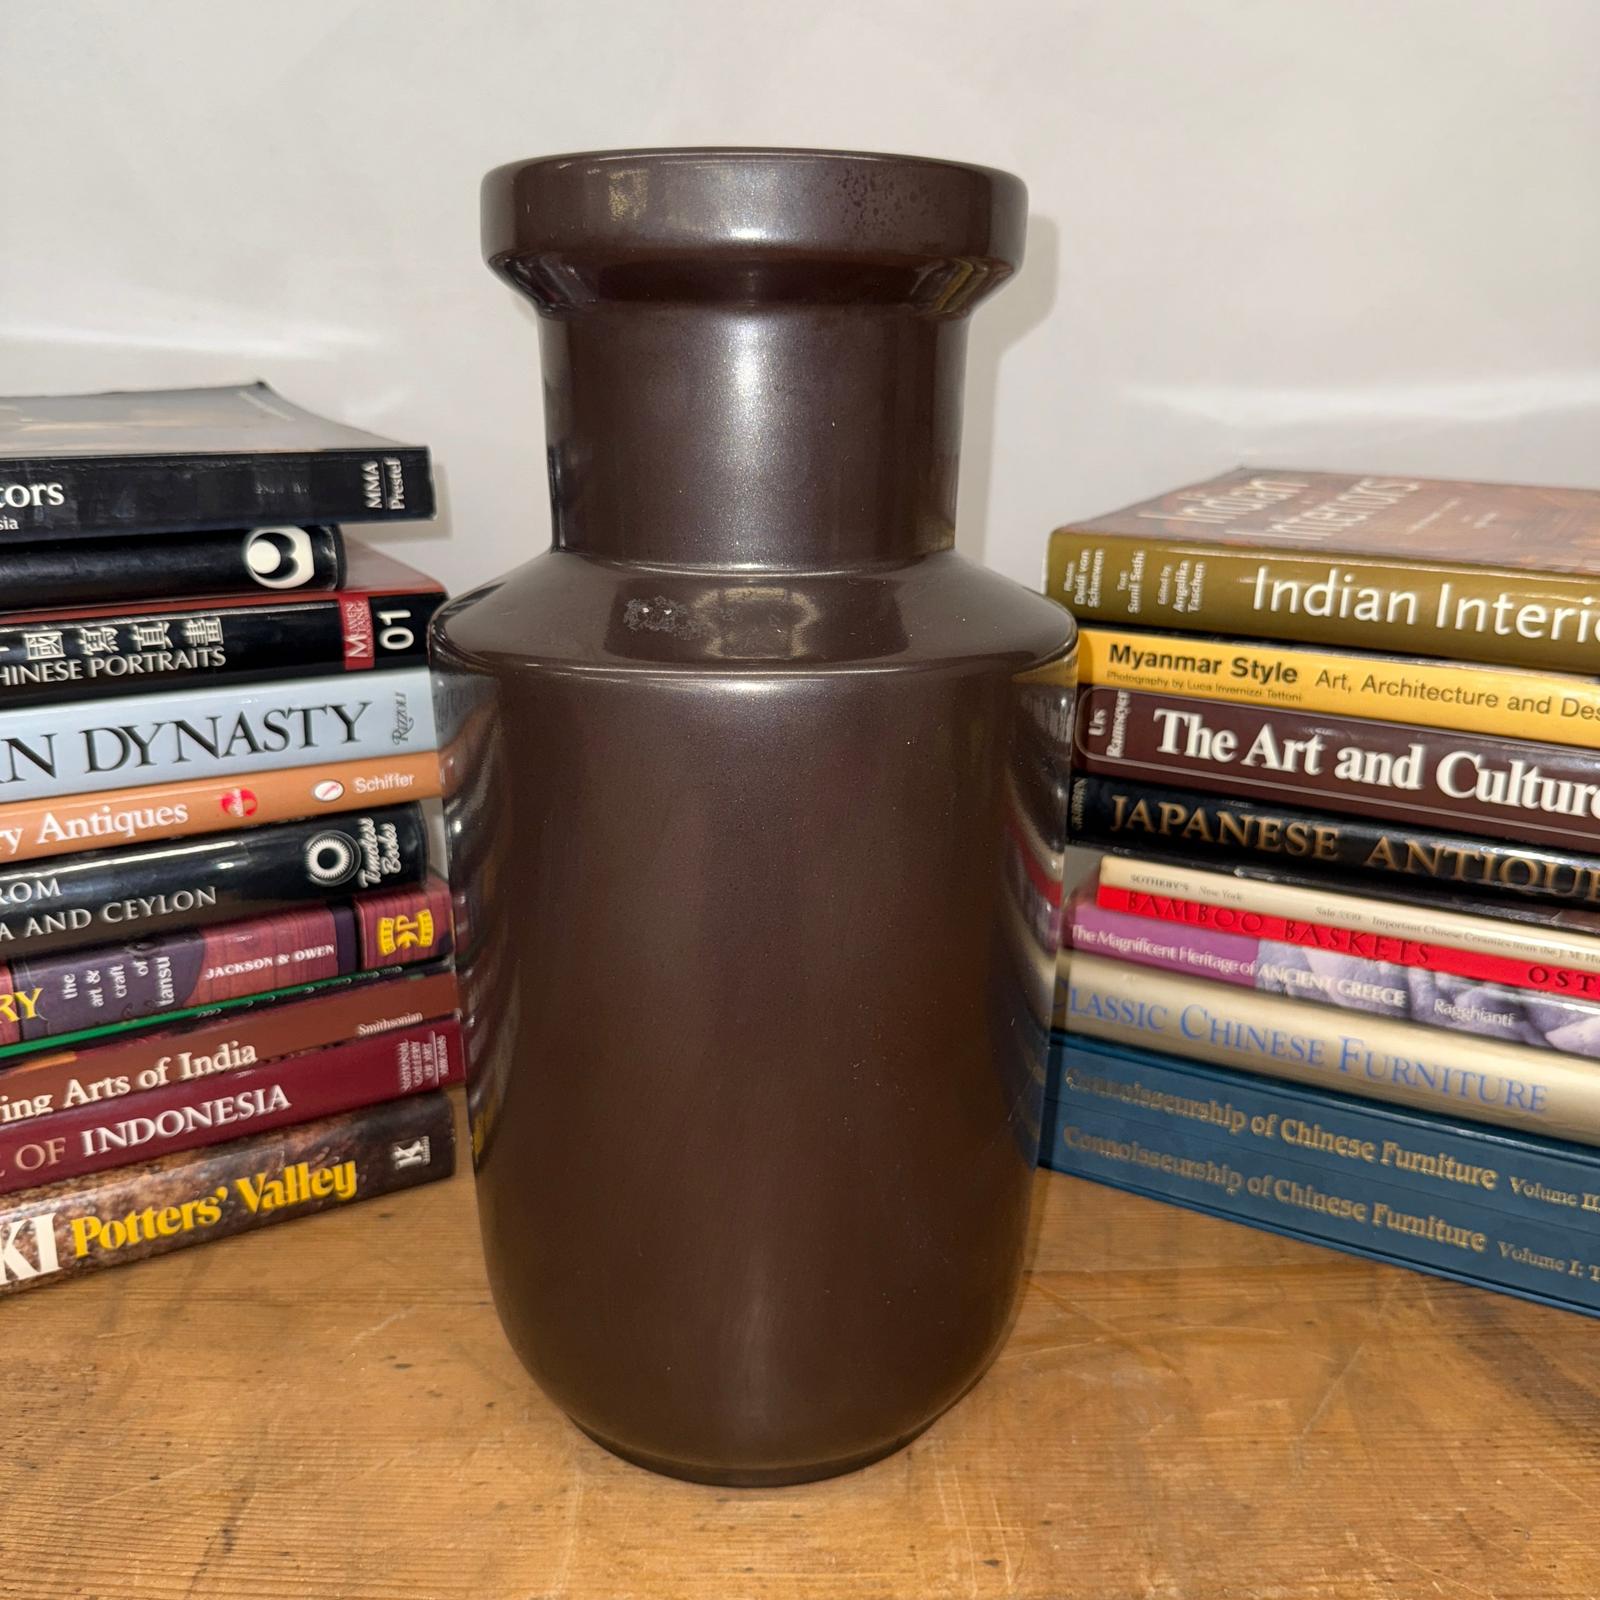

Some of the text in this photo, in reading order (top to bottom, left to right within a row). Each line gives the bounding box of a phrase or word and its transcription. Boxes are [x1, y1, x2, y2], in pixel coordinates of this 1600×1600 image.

[361, 459, 383, 509] MMA
[383, 457, 405, 510] Prestel
[1128, 550, 1145, 614] Sunil Sethi
[1173, 560, 1190, 612] Angelika
[1188, 561, 1205, 613] Taschen
[1253, 566, 1600, 644] Indian Interi
[0, 616, 224, 661] 國寫真畫
[377, 609, 415, 650] 01
[88, 647, 227, 678] PORTRAITS
[1106, 671, 1169, 688] Photography
[1172, 676, 1184, 690] by
[1186, 681, 1213, 692] Luca
[1109, 643, 1222, 675] Myanmar
[1231, 657, 1298, 684] Style
[1314, 669, 1352, 695] Art,
[1360, 674, 1499, 708] Architecture
[1507, 694, 1553, 715] and
[0, 701, 372, 784] N DYNASTY
[1088, 708, 1108, 737] Urs
[1152, 707, 1239, 764] The
[1240, 723, 1326, 776] Art
[1335, 743, 1425, 791] and
[353, 771, 415, 794] Schiffer
[37, 803, 189, 845] Antiques
[378, 822, 402, 875] Books
[1110, 795, 1341, 862] JAPANESE
[358, 817, 382, 888] Timeless
[24, 908, 92, 938] AND
[102, 886, 217, 924] CEYLON
[1130, 874, 1243, 902] SOTHEBY'S New York
[1128, 890, 1430, 965] BAMBOO BASKETS
[1372, 915, 1423, 936] Important
[1423, 924, 1462, 940] Chinese
[1463, 932, 1512, 949] Ceramics
[1512, 942, 1539, 953] from
[63, 974, 78, 999] the
[110, 964, 128, 998] craft
[133, 960, 149, 977] of
[155, 956, 175, 1007] tansu
[204, 943, 335, 980] JACKSON & OWEN
[1072, 924, 1097, 944] The
[1097, 930, 1178, 960] Magnificent
[1179, 946, 1238, 975] Heritage
[1239, 960, 1256, 978] of
[1258, 961, 1332, 990] ANCIENT
[1336, 978, 1408, 1008] GREECE
[86, 970, 104, 1008] art &
[1433, 998, 1515, 1028] Ragghianti
[358, 1012, 424, 1036] Smithsonian
[63, 1075, 131, 1109] Arts
[138, 1057, 171, 1091] of
[177, 1040, 258, 1081] India
[1180, 1003, 1325, 1066] CHINESE
[1339, 1035, 1550, 1114] FURNITURE
[15, 1084, 292, 1170] OF INDONESIA
[1065, 1067, 1247, 1136] Connoisseurship
[1251, 1113, 1279, 1137] of
[1280, 1118, 1376, 1162] Chinese
[1379, 1140, 1499, 1191] Furniture
[1509, 1175, 1578, 1208] Volume
[0, 1160, 357, 1284] KI Potters’ Valley
[1063, 1125, 1245, 1196] Connoisseurship
[1246, 1174, 1275, 1198] of
[1274, 1179, 1368, 1223] Chinese
[1371, 1202, 1488, 1252] Furniture
[1497, 1241, 1565, 1273] Volume
